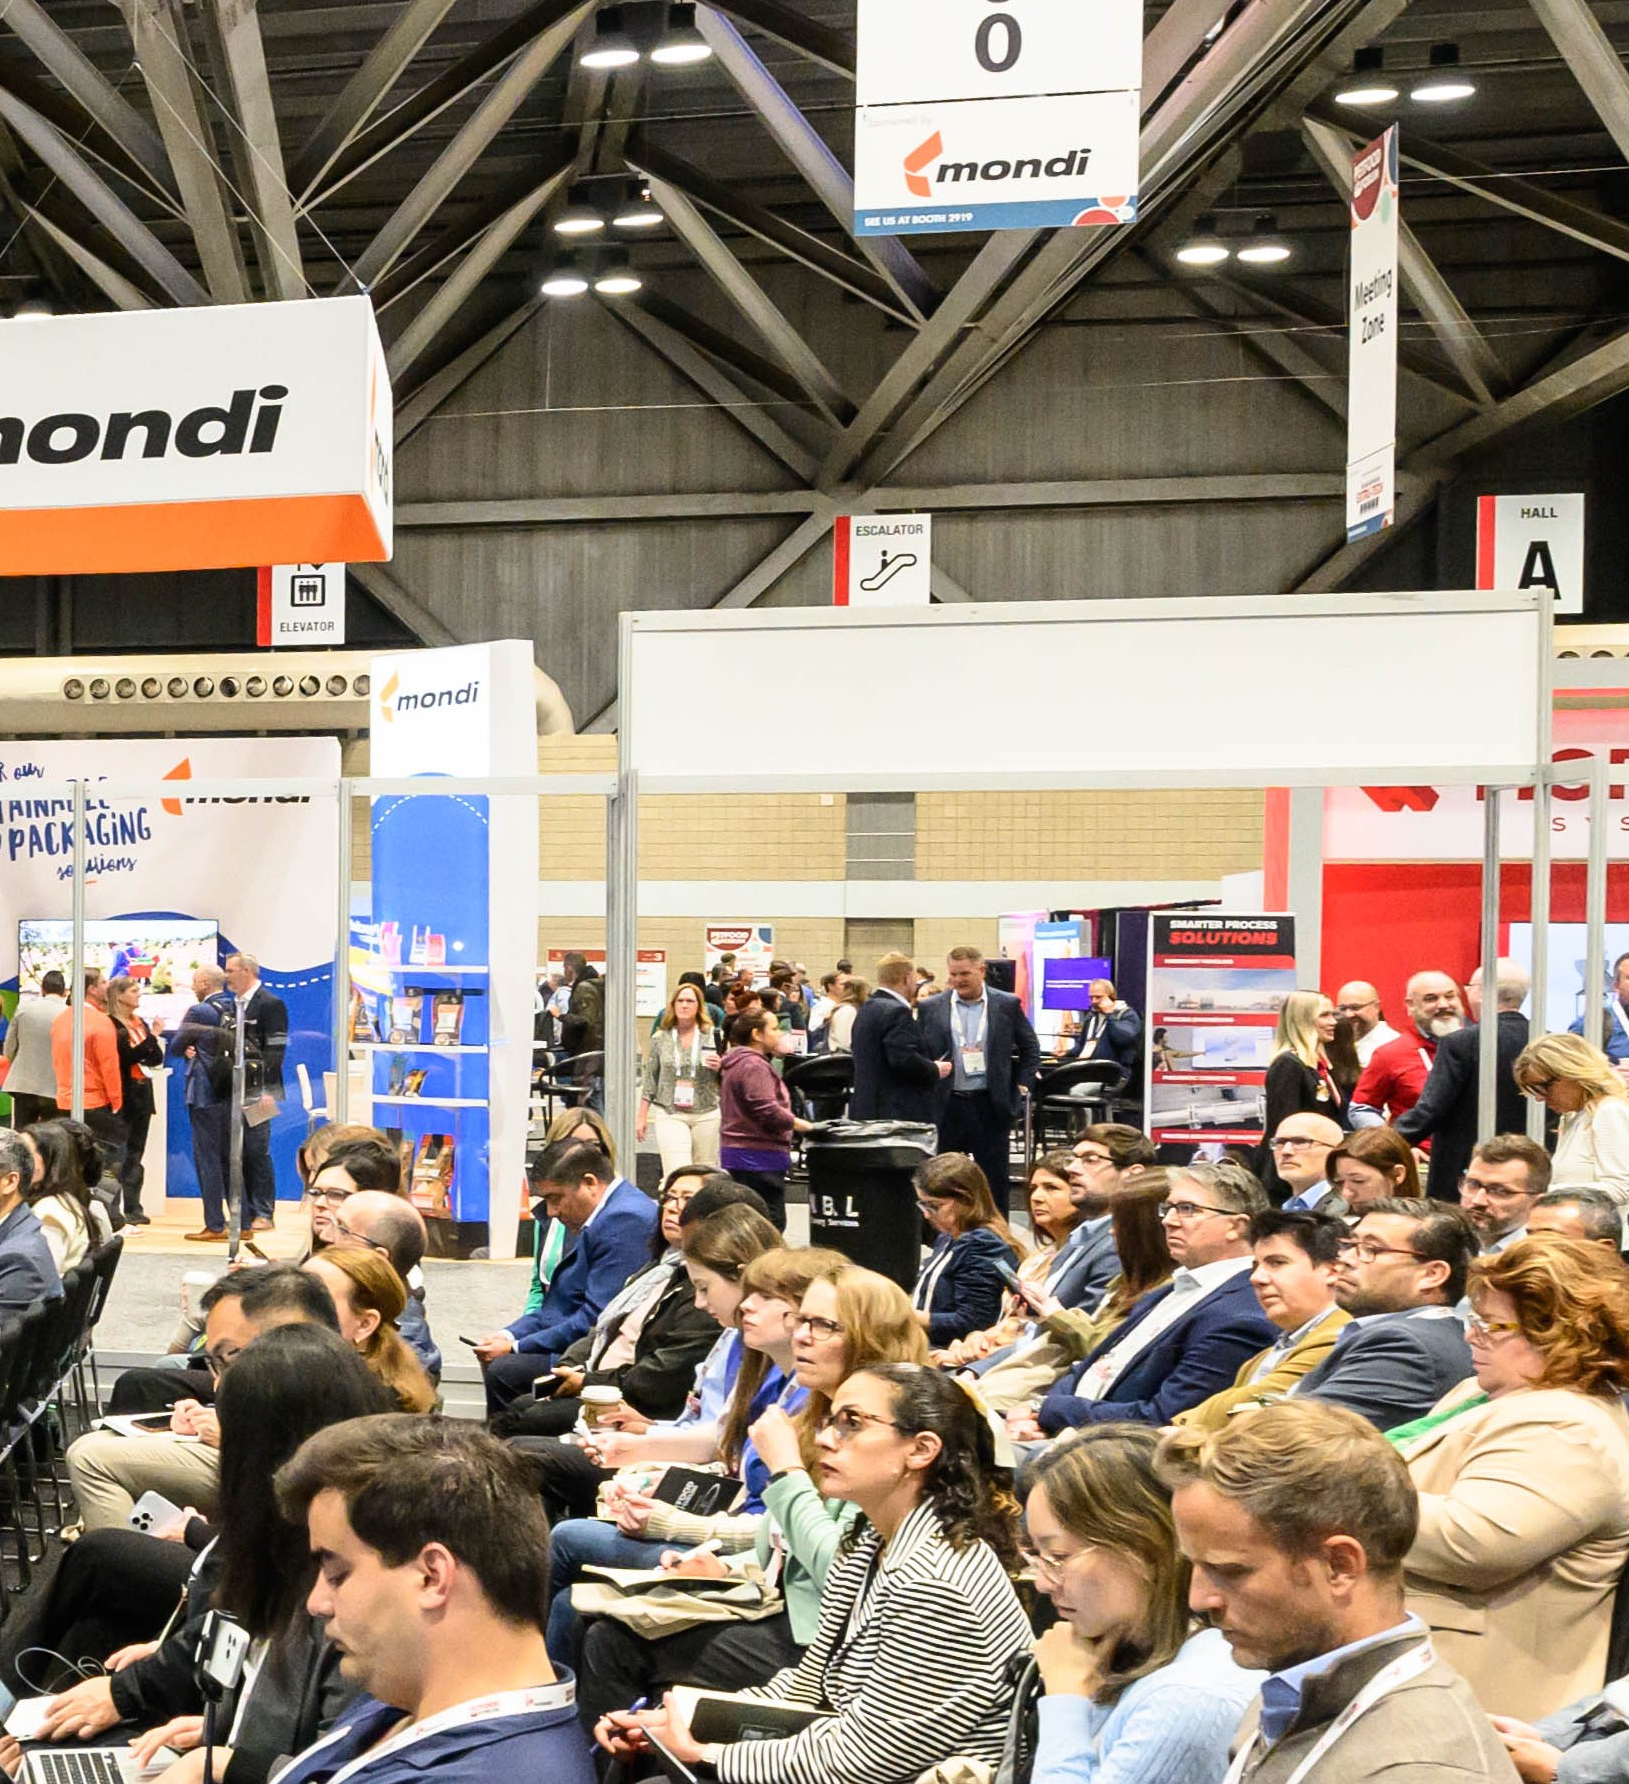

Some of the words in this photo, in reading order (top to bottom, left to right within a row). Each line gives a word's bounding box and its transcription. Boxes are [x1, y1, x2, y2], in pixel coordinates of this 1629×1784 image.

[974, 0, 1022, 73] 0
[936, 148, 1092, 183] mondi
[1361, 311, 1385, 344] Zone
[1520, 507, 1558, 518] HALL
[855, 522, 924, 537] ESCALATOR
[1517, 540, 1563, 600] A
[279, 621, 335, 632] ELEVATOR
[397, 681, 480, 711] mondi
[1169, 920, 1224, 930] SMARTER
[1225, 920, 1278, 930] PROCESS
[1168, 931, 1278, 946] SOLUTIONS
